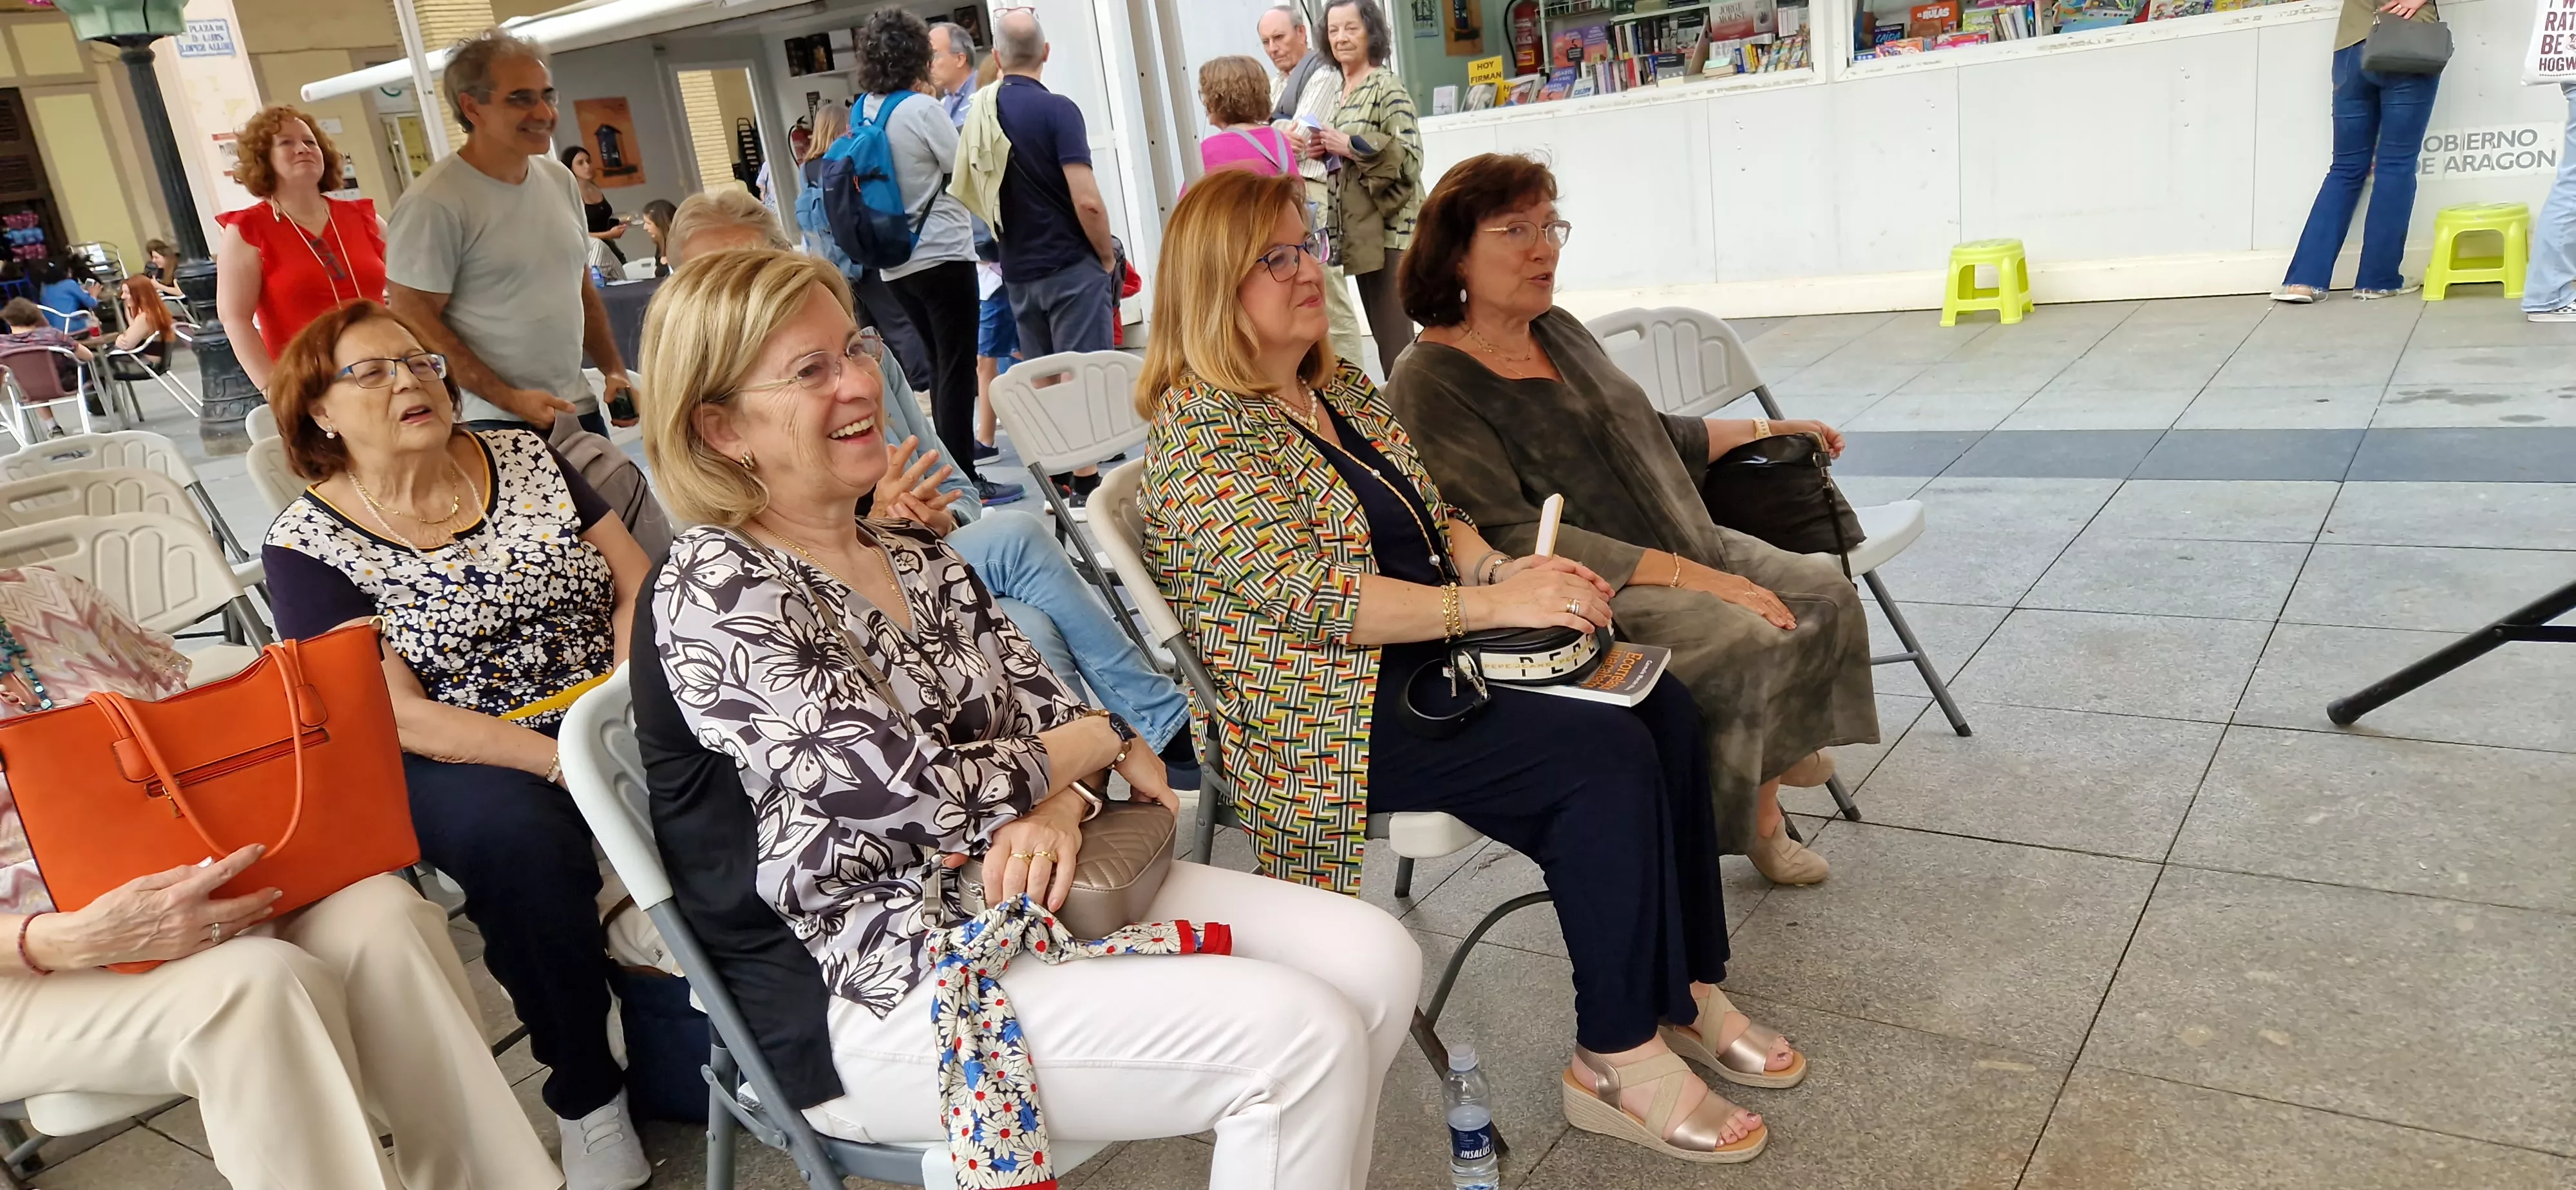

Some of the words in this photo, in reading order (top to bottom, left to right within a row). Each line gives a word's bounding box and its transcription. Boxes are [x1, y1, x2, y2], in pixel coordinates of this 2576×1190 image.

[1719, 3, 1743, 14] JORGE
[1718, 12, 1745, 23] MOLIST
[2541, 33, 2564, 55] BE
[1477, 61, 1495, 71] HOY
[1470, 71, 1502, 84] FIRMAN
[2423, 129, 2538, 153] OBIERNO
[2445, 149, 2557, 174] ARAGON
[1461, 1144, 1490, 1158] INSALUS
